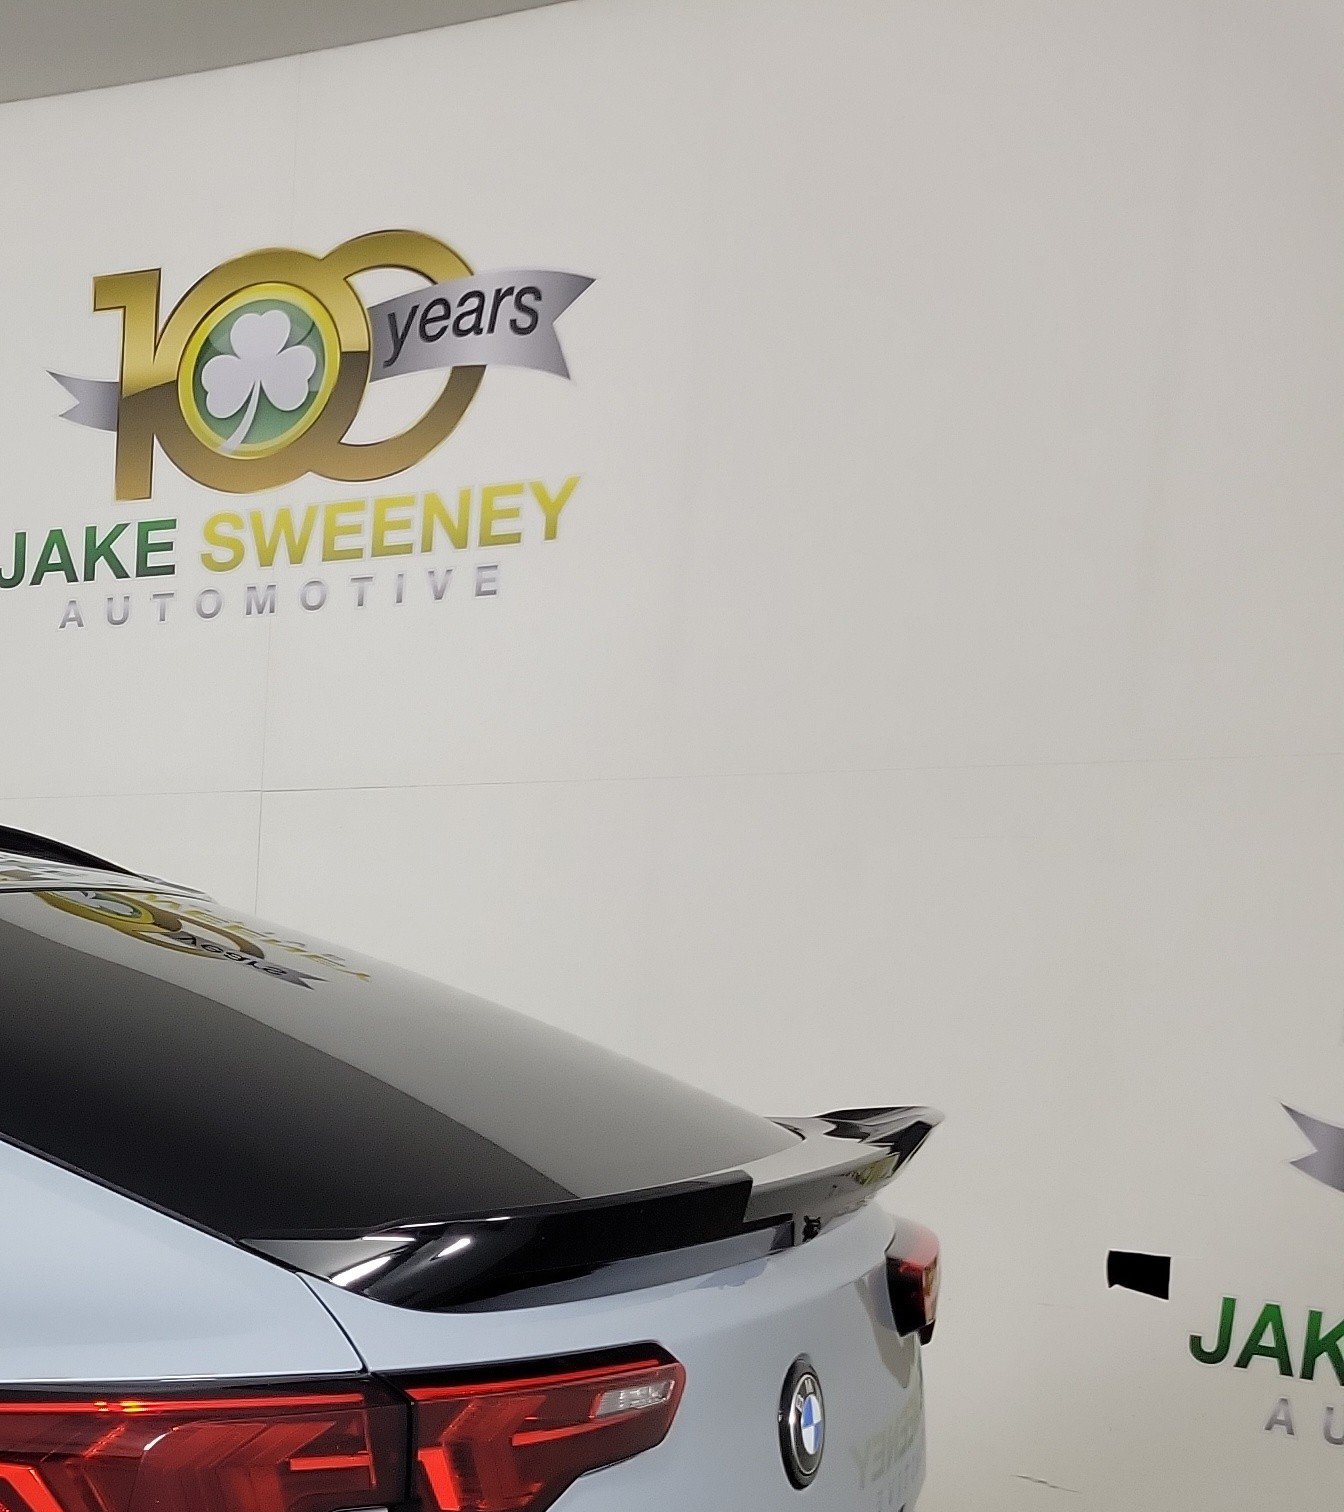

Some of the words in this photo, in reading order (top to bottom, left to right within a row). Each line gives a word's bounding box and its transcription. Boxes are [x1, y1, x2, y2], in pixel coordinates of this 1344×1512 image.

[382, 284, 543, 368] years
[200, 475, 581, 573] SWEENEY
[58, 564, 499, 629] AUTOMOTIVE
